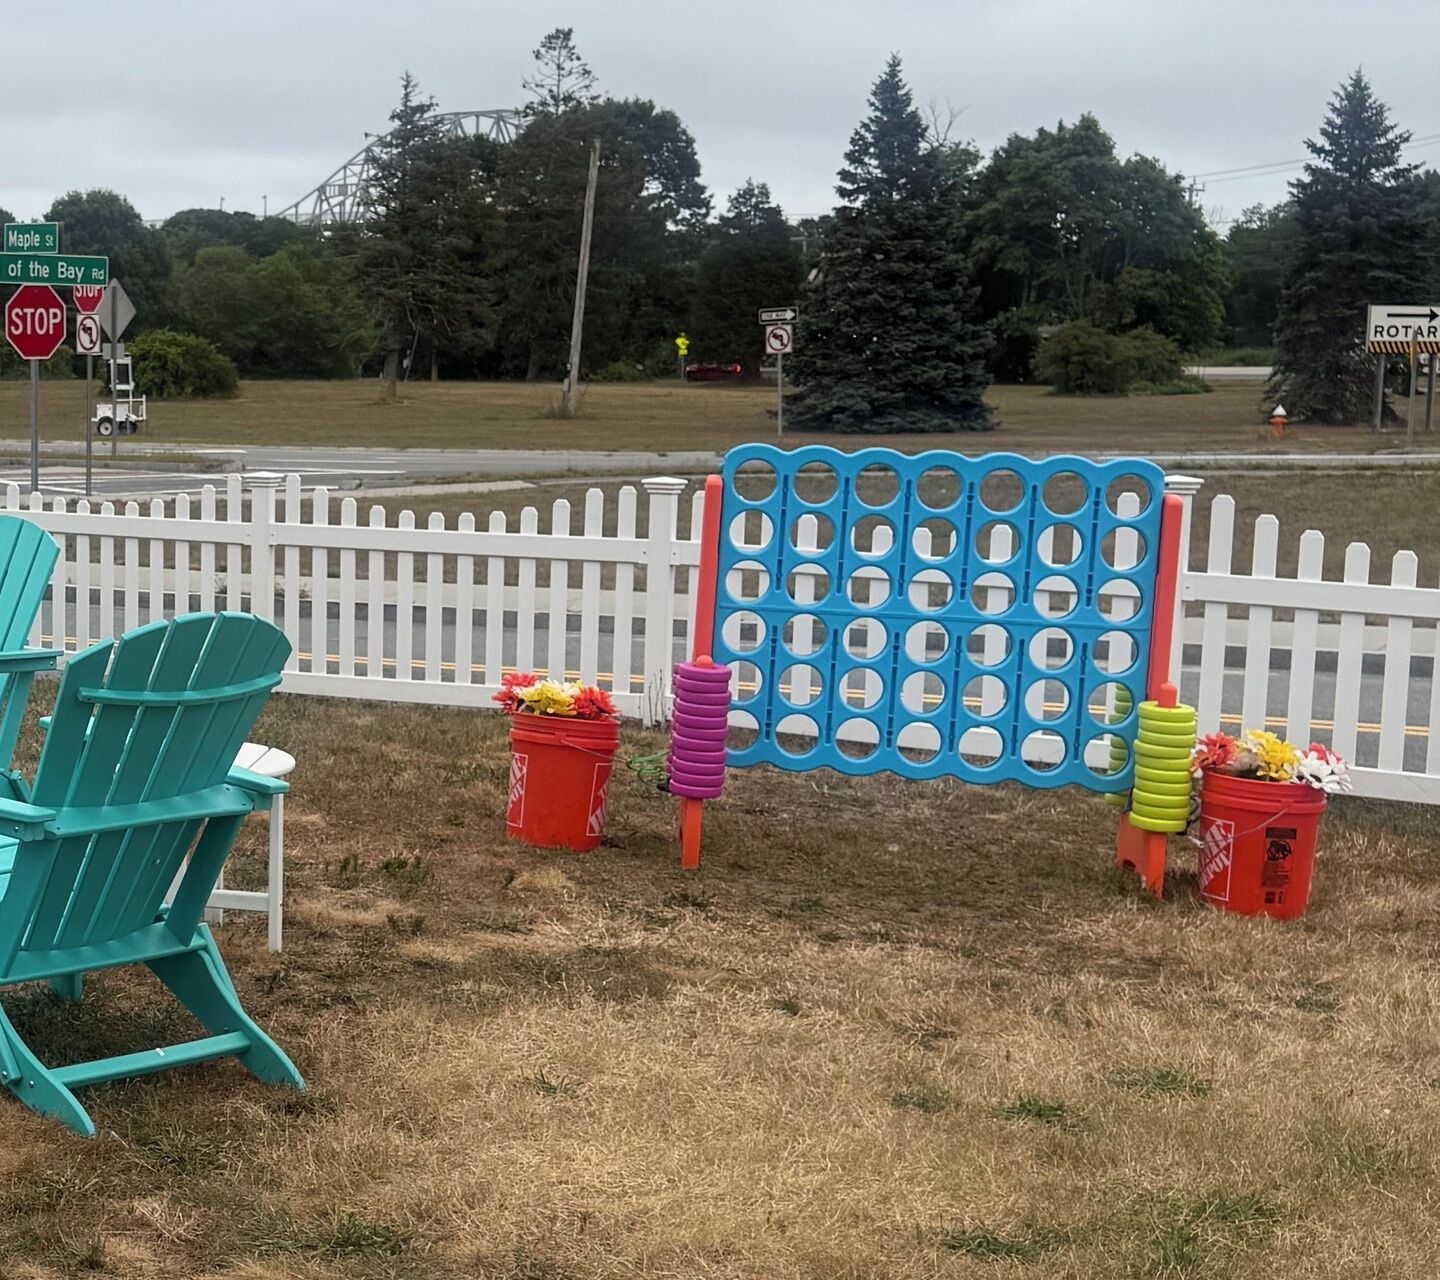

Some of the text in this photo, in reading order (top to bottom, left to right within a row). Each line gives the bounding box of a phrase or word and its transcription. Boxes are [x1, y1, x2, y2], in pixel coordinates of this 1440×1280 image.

[8, 230, 54, 250] Maple St
[8, 260, 22, 277] of
[29, 261, 50, 277] the
[57, 262, 85, 283] Bay
[92, 268, 105, 280] Rd
[75, 285, 101, 297] STOP
[10, 308, 61, 336] STOP
[1373, 324, 1440, 338] ROTAR
